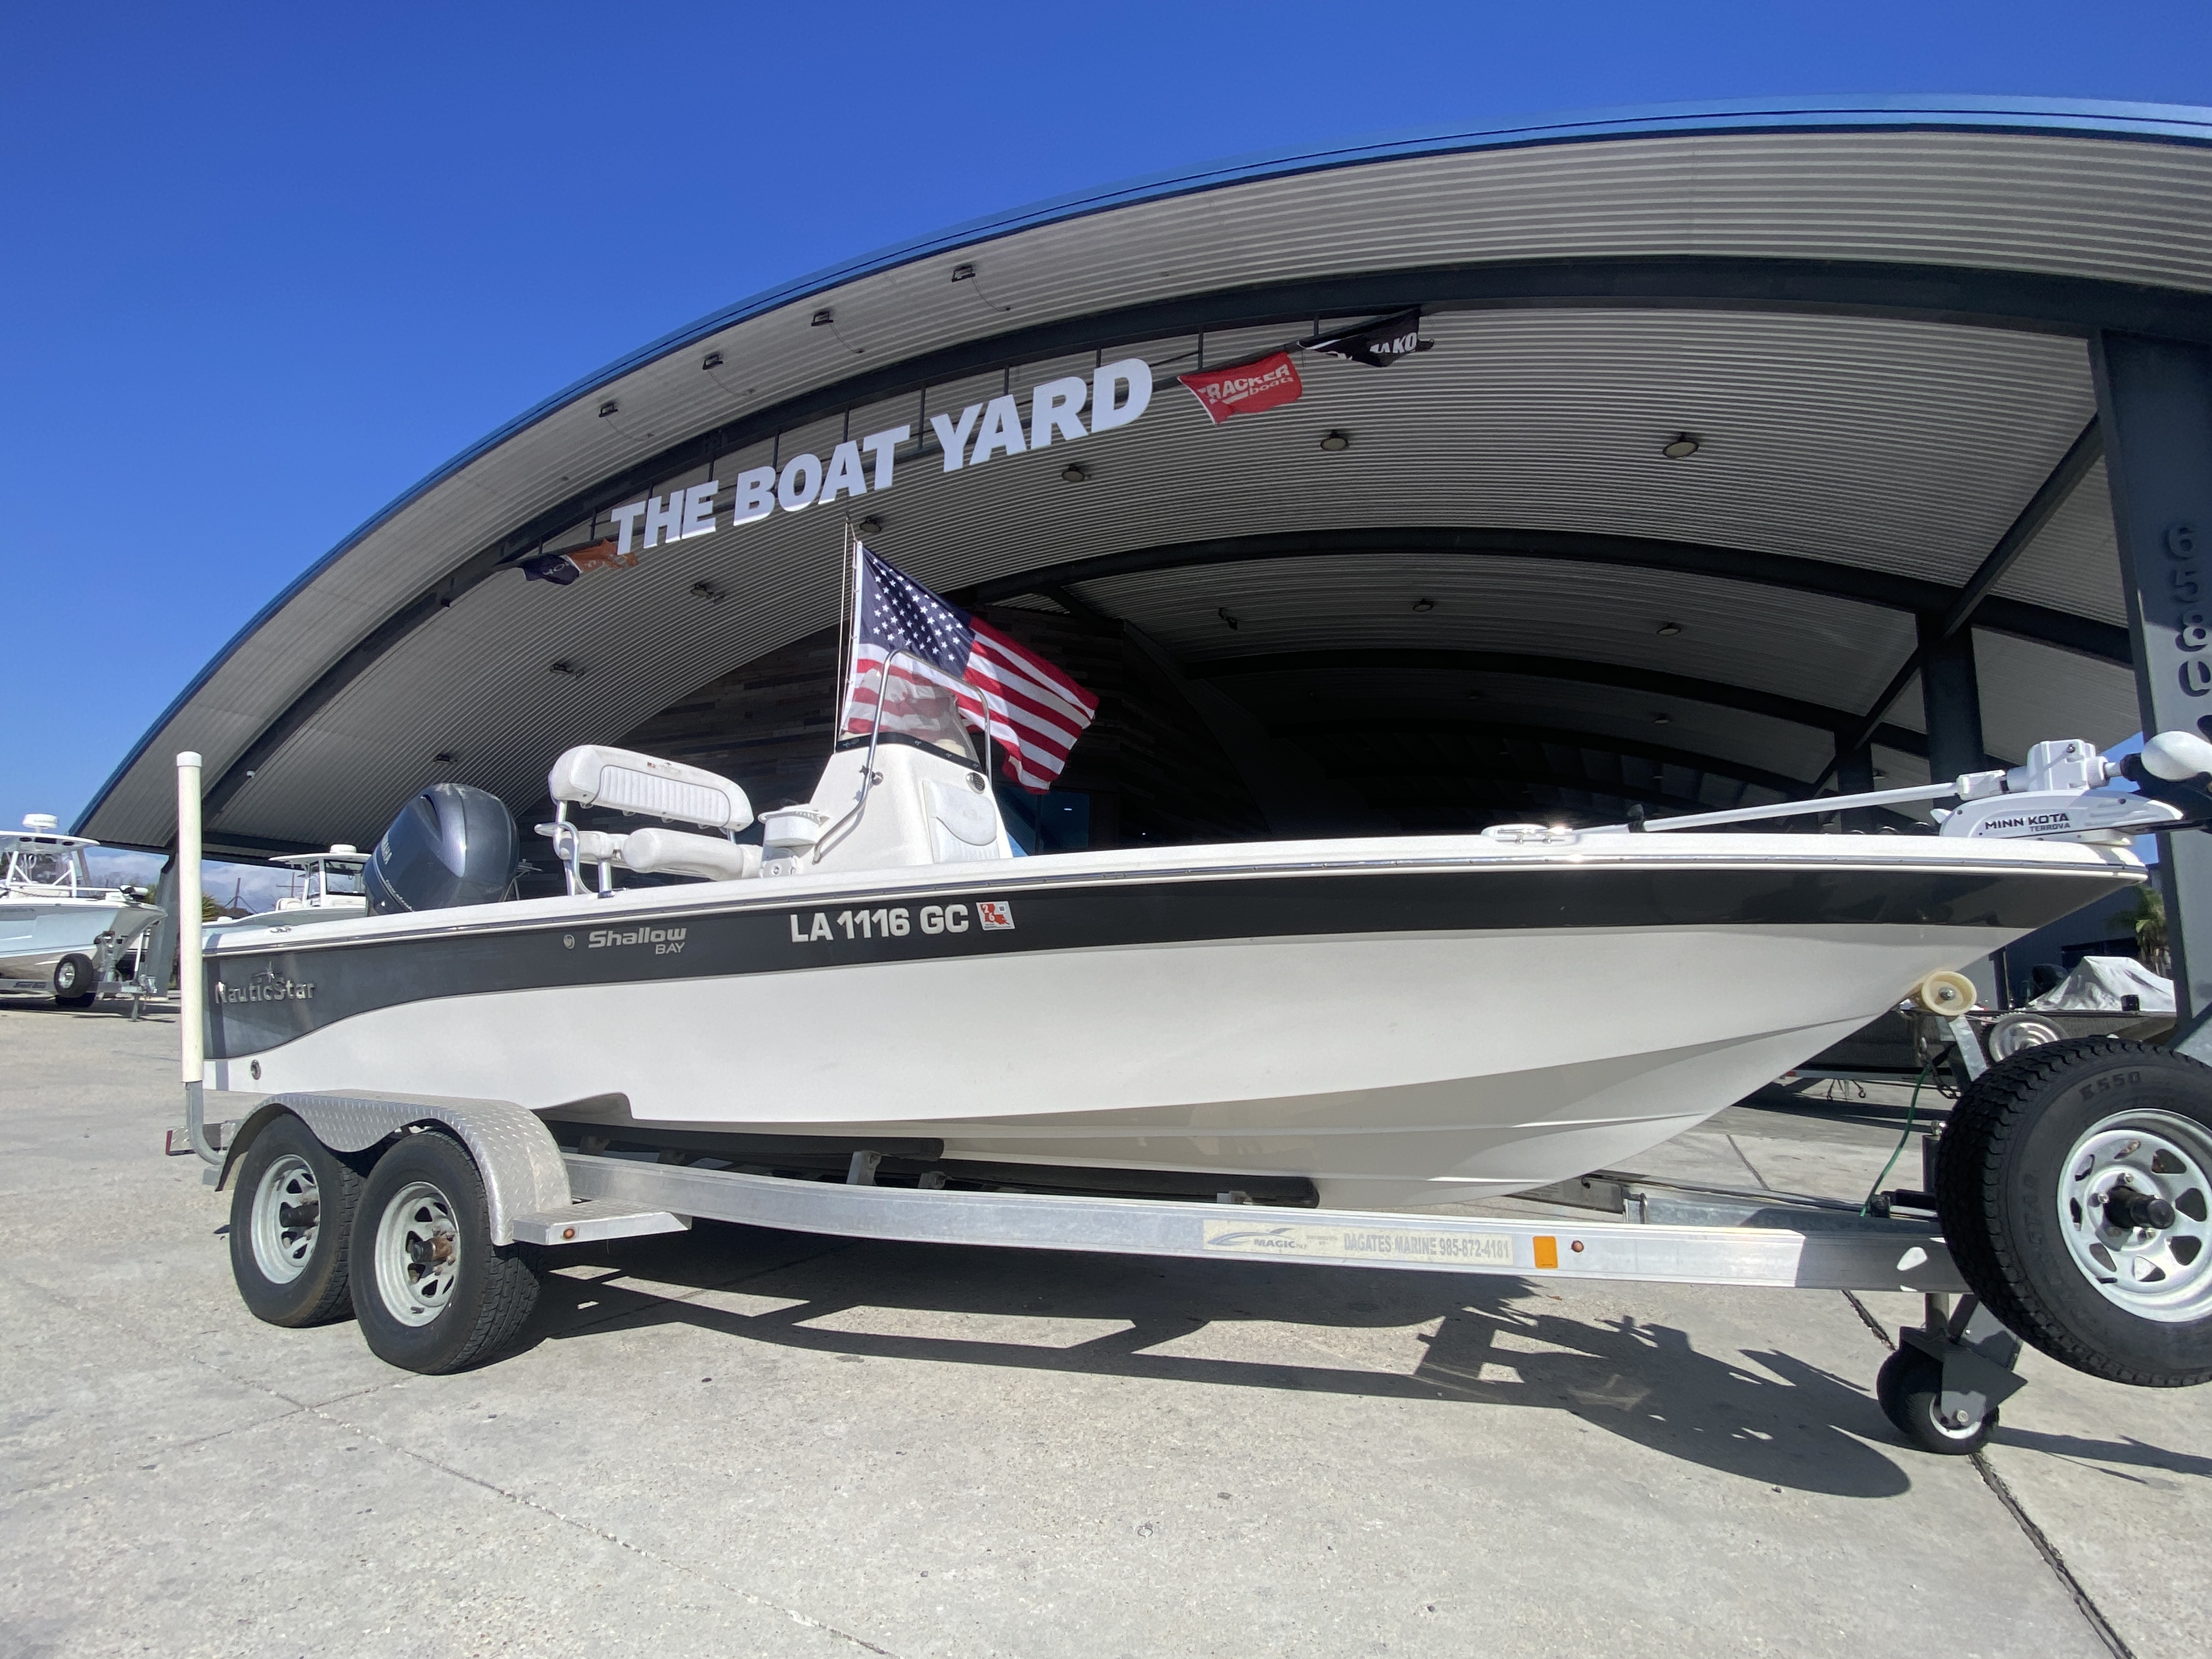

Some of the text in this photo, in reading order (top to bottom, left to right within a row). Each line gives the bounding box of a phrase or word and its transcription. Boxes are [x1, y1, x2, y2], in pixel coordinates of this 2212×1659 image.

[611, 358, 1153, 555] THE BOAT YARD
[1985, 813, 2069, 830] MINN KOTA
[2029, 823, 2070, 832] TERROVA
[791, 904, 969, 943] LA 1116 GC
[588, 927, 687, 949] Shallow
[656, 941, 685, 955] BAY
[1254, 1239, 1295, 1249] MAGIC
[1344, 1233, 1509, 1259] DAGATES MARINE 985-872-4181
